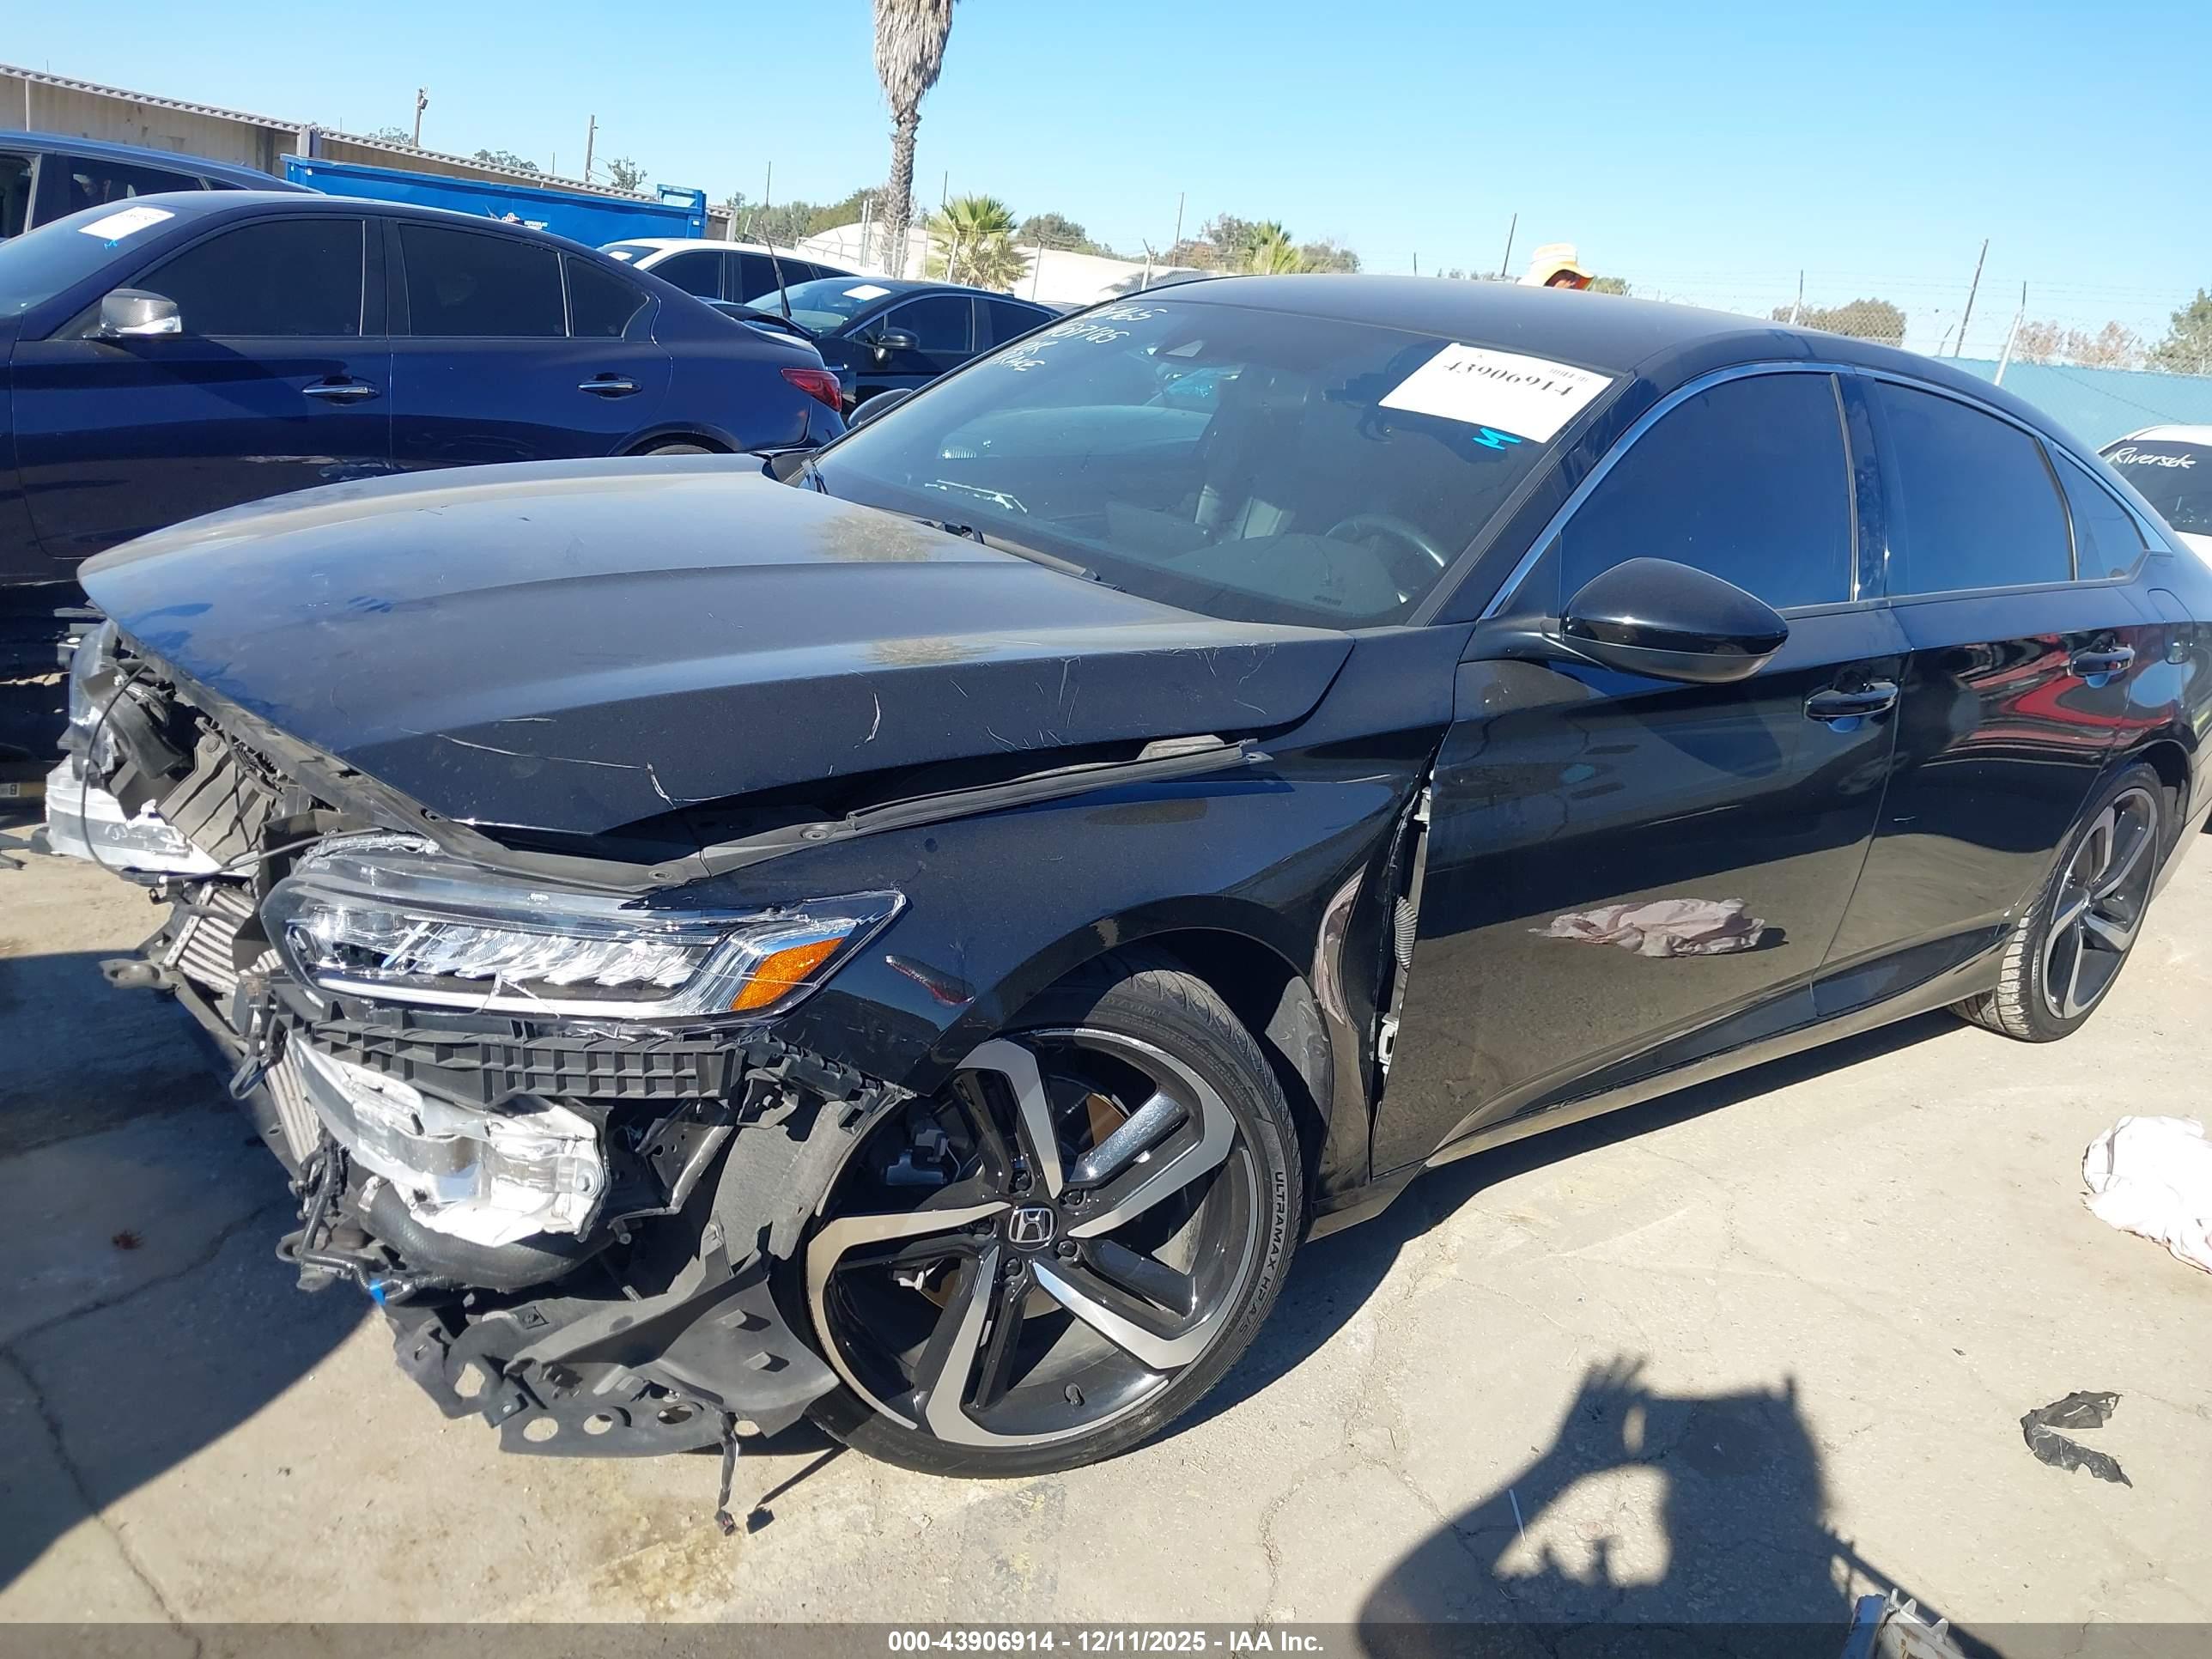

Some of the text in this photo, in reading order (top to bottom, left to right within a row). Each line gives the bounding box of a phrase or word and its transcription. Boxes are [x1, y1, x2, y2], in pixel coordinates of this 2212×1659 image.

[1443, 360, 1575, 397] 43906914
[1267, 1170, 1287, 1270] ULTRAMAX
[1256, 1277, 1272, 1303] HP
